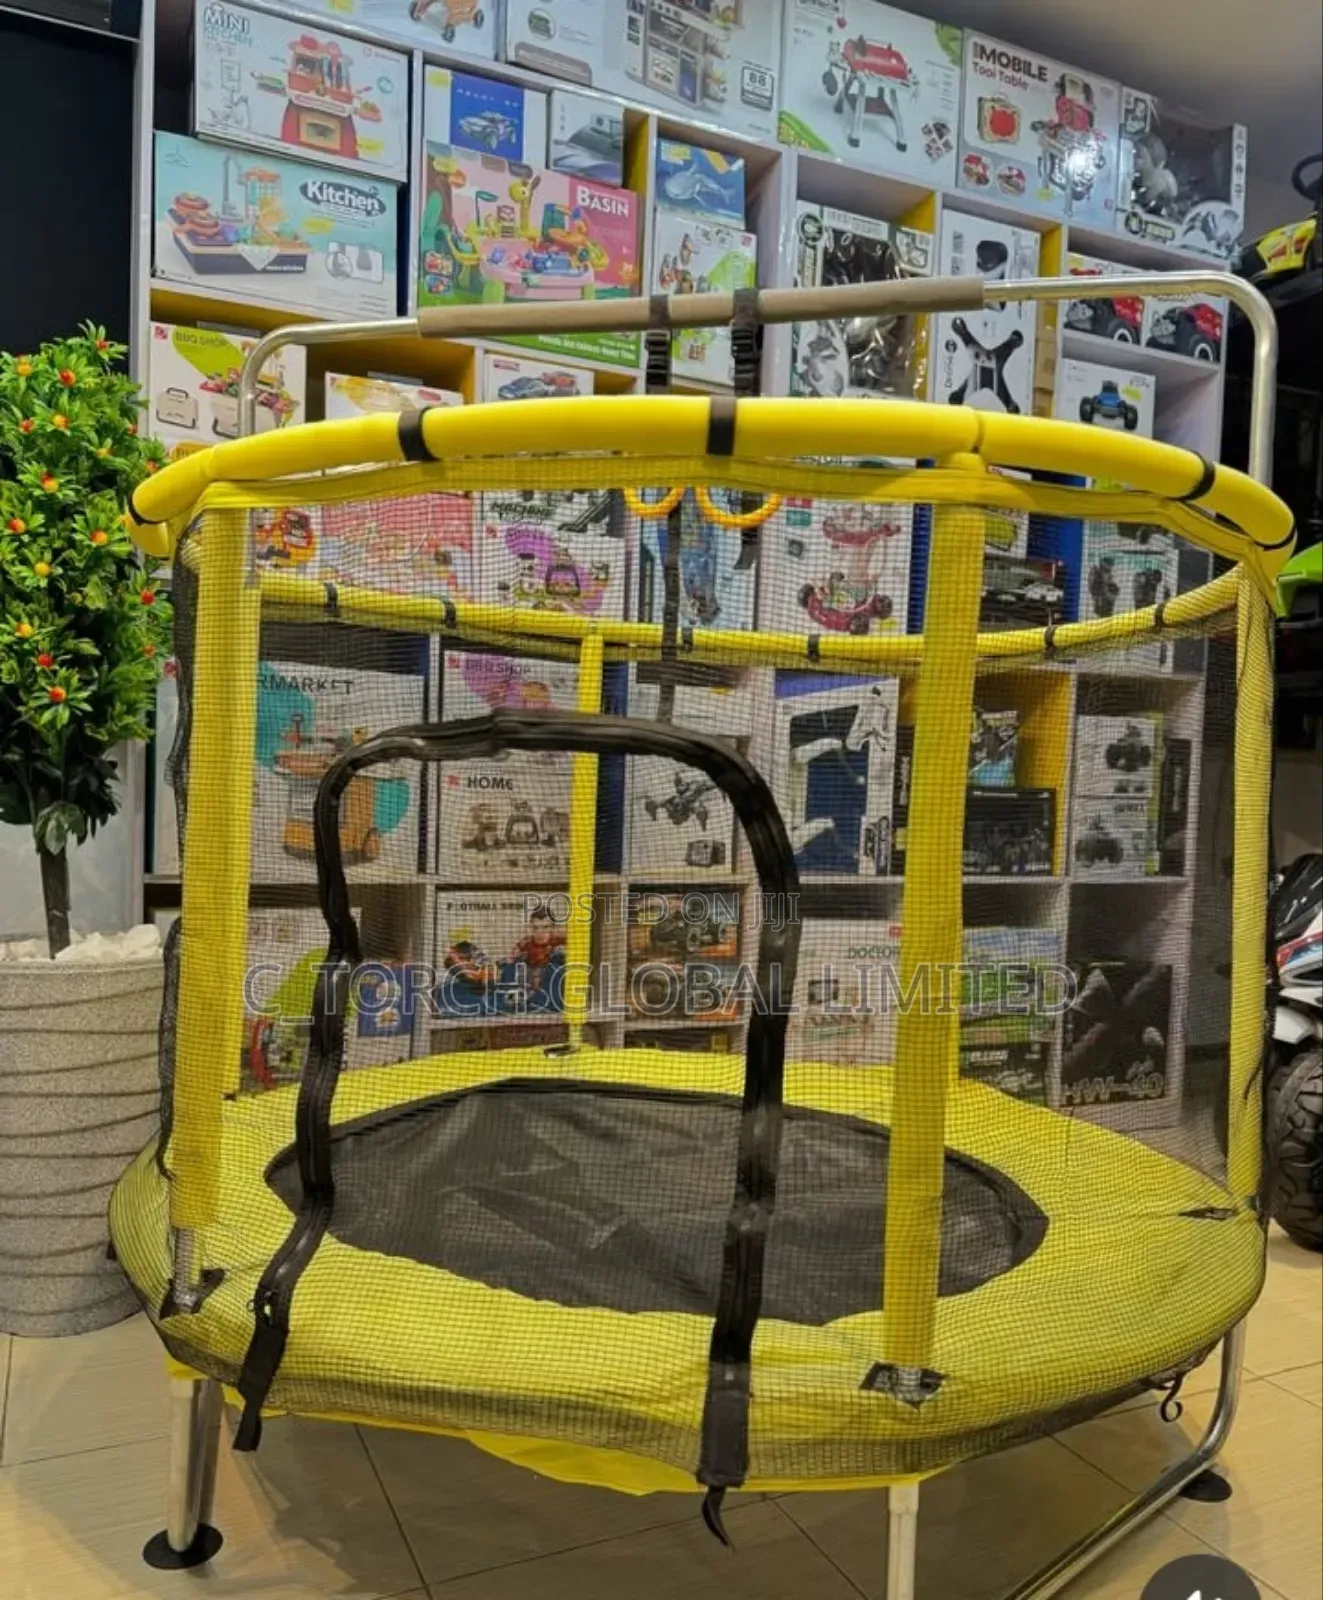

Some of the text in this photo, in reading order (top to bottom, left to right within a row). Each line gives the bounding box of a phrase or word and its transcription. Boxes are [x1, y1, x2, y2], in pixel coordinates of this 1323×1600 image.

[980, 43, 1048, 82] MOBILE
[307, 181, 380, 211] Kitchen
[577, 185, 629, 218] BASIN
[468, 775, 513, 790] HOME
